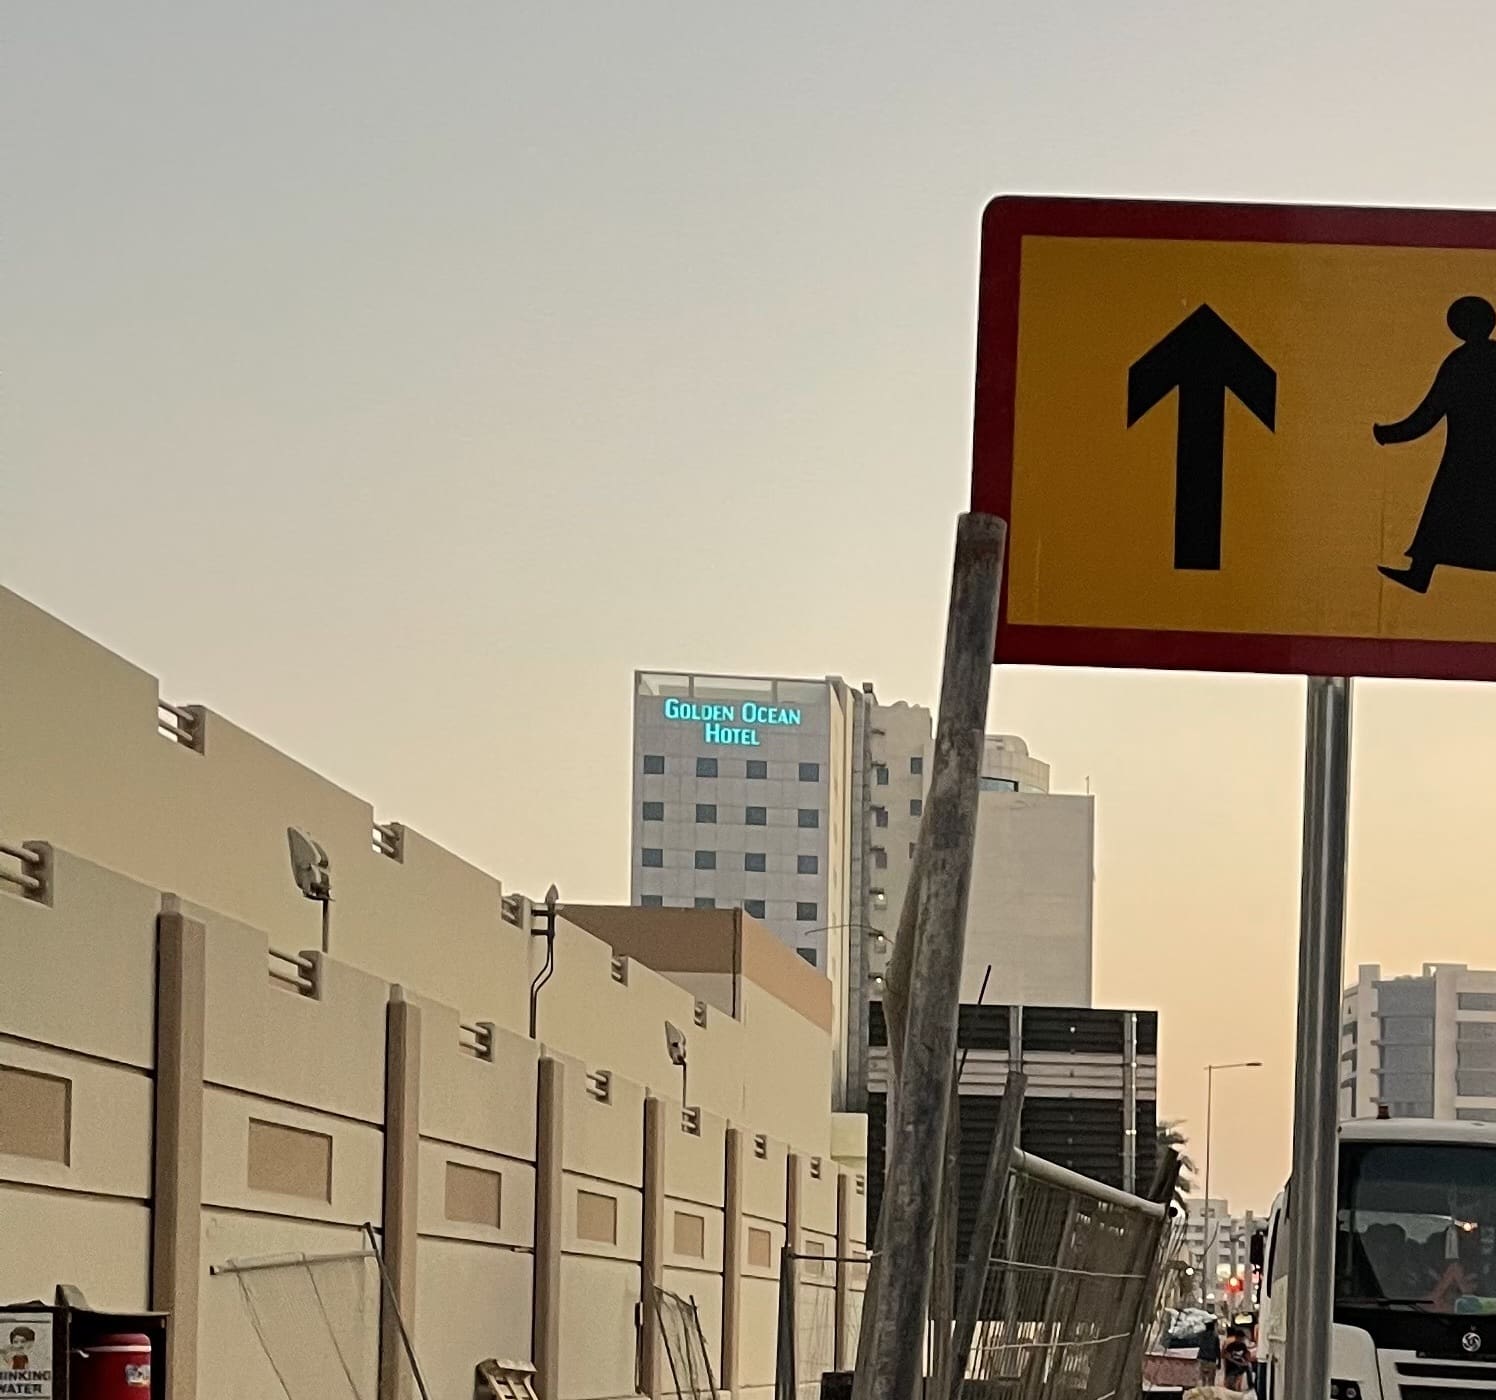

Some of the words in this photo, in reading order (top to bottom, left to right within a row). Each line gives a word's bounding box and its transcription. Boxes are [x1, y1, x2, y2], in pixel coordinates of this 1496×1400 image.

[664, 698, 735, 722] GOLDEN
[742, 702, 801, 725] OCEAN
[704, 723, 761, 746] HOTEL
[0, 1370, 51, 1381] INKING
